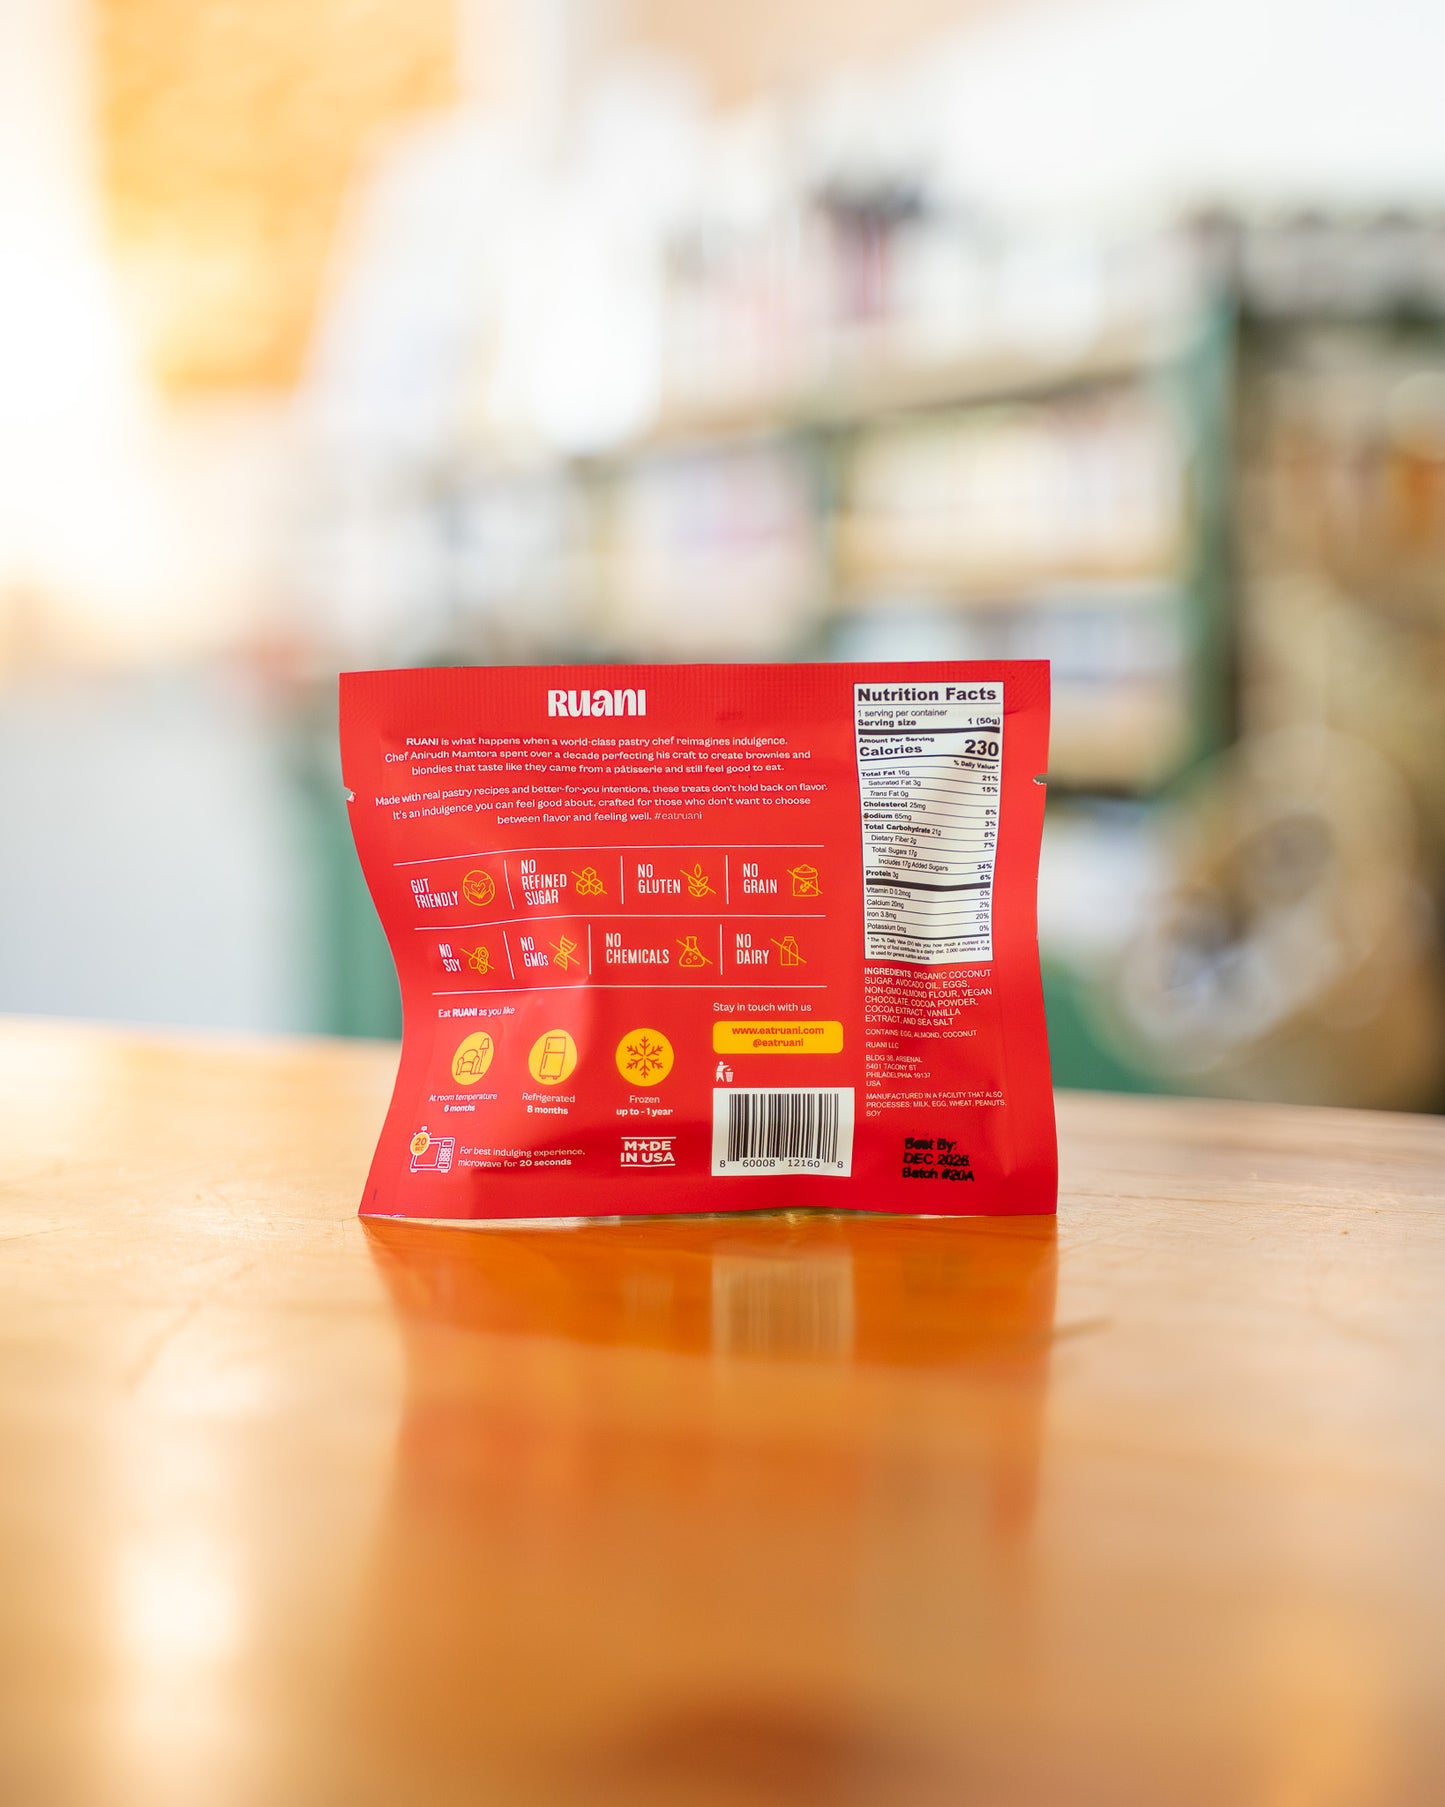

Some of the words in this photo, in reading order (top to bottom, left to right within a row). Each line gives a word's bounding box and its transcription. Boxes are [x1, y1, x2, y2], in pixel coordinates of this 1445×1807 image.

[858, 688, 938, 701] Nutrition
[946, 687, 996, 700] Facts
[406, 738, 438, 746] RUANI
[451, 737, 476, 745] what
[479, 737, 520, 746] happens
[560, 738, 616, 746] world-class
[618, 738, 650, 747] pastry
[652, 736, 674, 745] chef
[677, 738, 730, 747] reimagines
[732, 737, 788, 747] indulgence.
[860, 745, 922, 756] Calories
[965, 739, 999, 756] 230
[385, 752, 409, 763] Chef
[411, 751, 449, 759] Anirudh
[452, 750, 497, 758] Mamtora
[500, 750, 528, 760] spent
[563, 751, 599, 760] decade
[602, 751, 654, 760] perfecting
[656, 751, 670, 759] his
[673, 751, 696, 759] craft
[746, 751, 790, 759] brownies
[793, 751, 810, 759] and
[961, 761, 975, 769] Daily
[376, 796, 400, 806] Made
[402, 792, 421, 803] with
[423, 790, 440, 800] real
[442, 789, 472, 799] pastry
[474, 786, 510, 796] recipes
[512, 786, 529, 794] and
[532, 784, 599, 795] better-for-you
[602, 785, 650, 795] intentions,
[653, 785, 679, 793] these
[681, 785, 710, 793] treats
[738, 784, 758, 792] hold
[761, 783, 783, 792] back
[800, 783, 828, 791] flavor.
[498, 815, 540, 825] between
[543, 814, 571, 823] flavor
[573, 813, 591, 822] and
[594, 812, 627, 822] feeling
[630, 811, 651, 821] well.
[654, 811, 702, 820] #eatruani
[887, 825, 930, 834] Carbohydrate
[521, 860, 536, 874] NO
[638, 864, 653, 878] NO
[743, 863, 758, 877] NO
[411, 878, 429, 893] GUT
[521, 874, 567, 890] REFINED
[638, 880, 680, 893] GLUTEN
[744, 880, 777, 893] GRAIN
[415, 891, 458, 908] FRIENDLY
[525, 890, 558, 905] SUGAR
[520, 937, 534, 951] NO
[606, 933, 621, 947] NO
[736, 934, 751, 948] NO
[439, 944, 452, 957] NO
[606, 949, 669, 964] CHEMICALS
[737, 950, 769, 964] DAIRY
[443, 959, 461, 972] SOY
[524, 953, 548, 967] GMOs
[914, 971, 947, 979] ORGANIC
[949, 969, 991, 978] COCONUT
[865, 987, 901, 995] NON-GMO
[902, 989, 927, 998] ALMOND
[961, 988, 991, 996] VEGAN
[438, 1008, 451, 1018] Eat
[452, 1008, 477, 1017] RUANI
[479, 1008, 487, 1016] as
[488, 1008, 501, 1017] you
[503, 1006, 515, 1015] like
[713, 1003, 735, 1013] Stay
[737, 1003, 745, 1011] in
[748, 1003, 775, 1011] touch
[777, 1003, 798, 1011] with
[800, 1004, 811, 1012] us
[934, 1018, 953, 1026] SALT
[732, 1026, 824, 1035] www.eatruani.com
[753, 1038, 803, 1048] @eatruani
[429, 1094, 437, 1102] At
[456, 1093, 498, 1101] temperature
[522, 1092, 575, 1102] Refrigerated
[629, 1095, 659, 1103] Frozen
[534, 1106, 568, 1114] months
[616, 1108, 628, 1116] up
[651, 1108, 673, 1117] year
[474, 1147, 491, 1155] best
[493, 1149, 531, 1158] indulging
[621, 1152, 639, 1162] IN
[642, 1152, 674, 1163] USA
[904, 1152, 933, 1164] DEC
[458, 1159, 501, 1167] microwave
[720, 1160, 725, 1168] 8
[788, 1160, 820, 1168] 12160
[837, 1161, 843, 1169] 8
[902, 1167, 938, 1178] Batch
